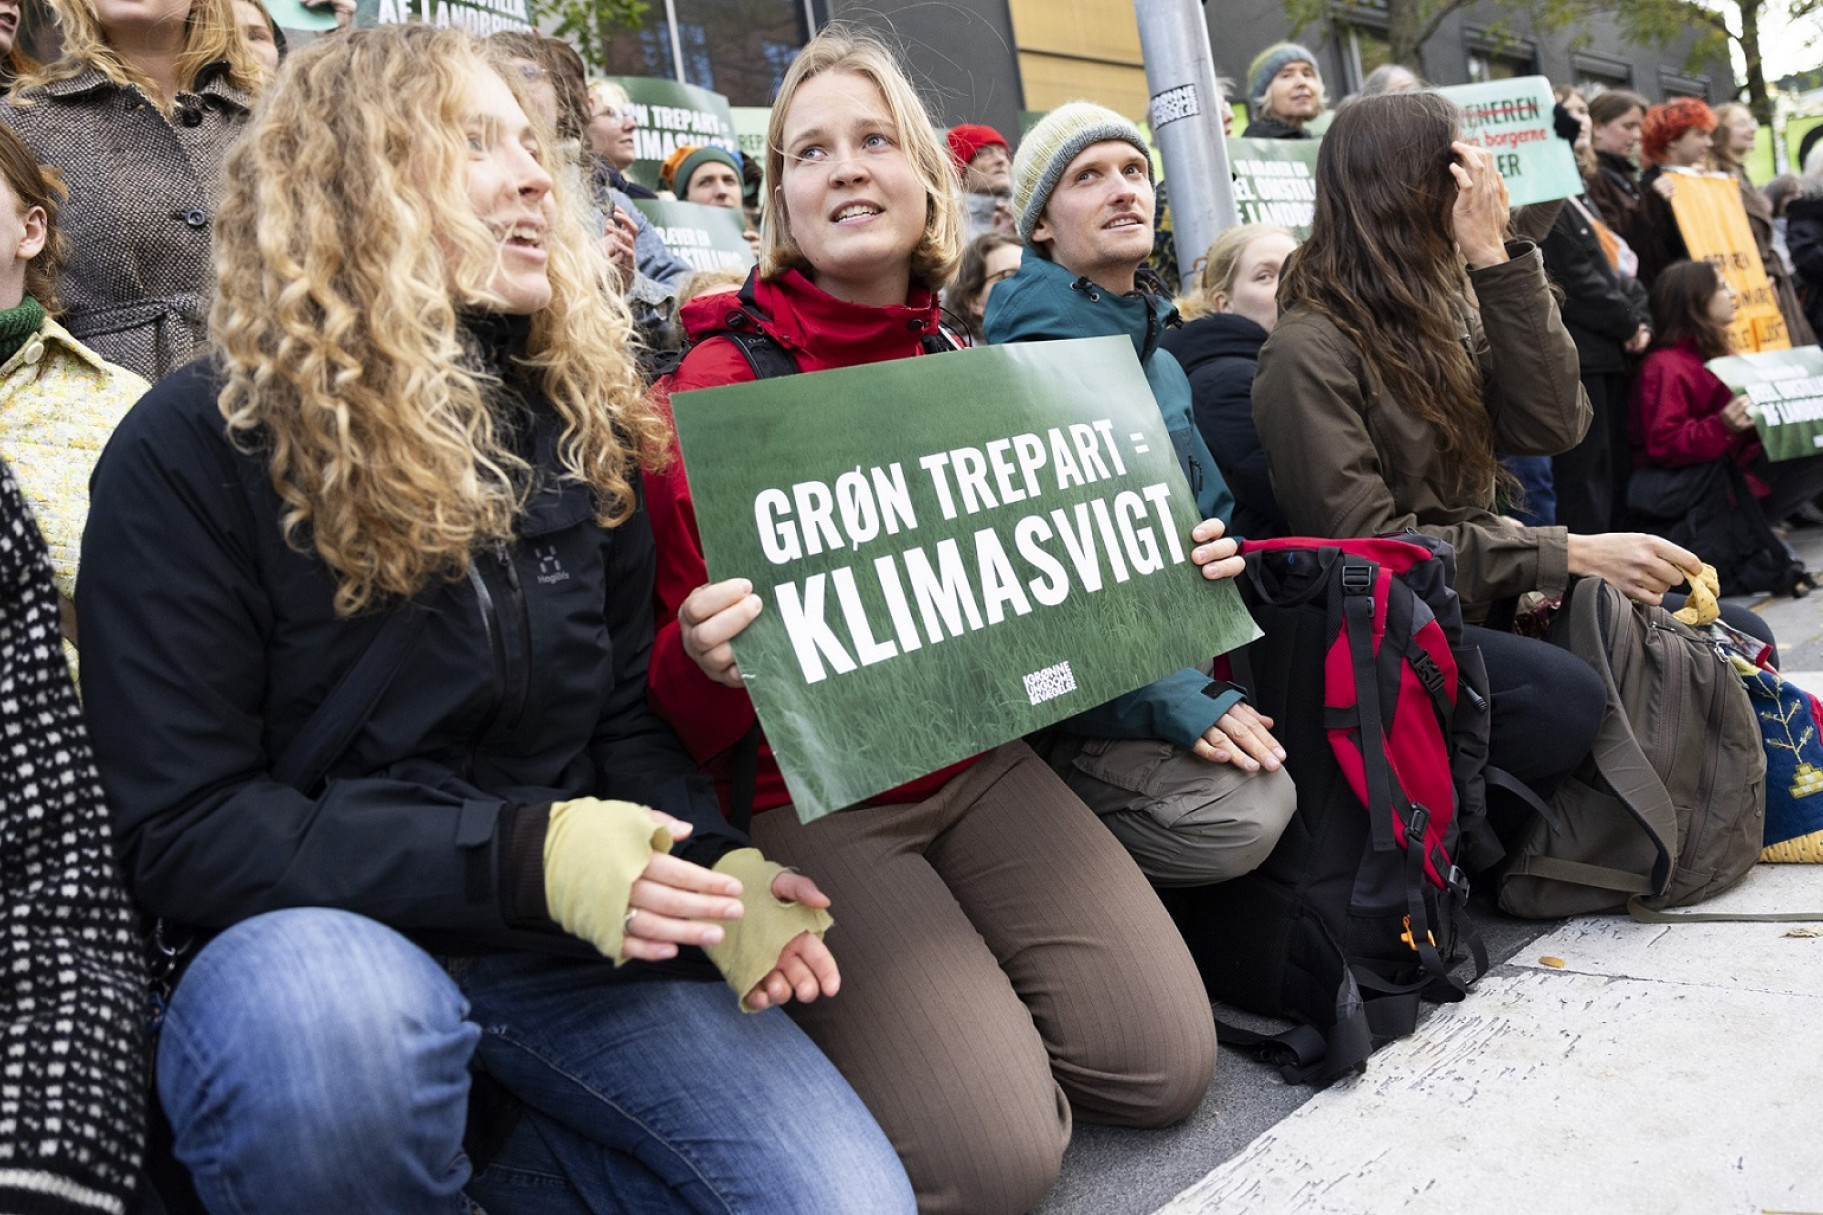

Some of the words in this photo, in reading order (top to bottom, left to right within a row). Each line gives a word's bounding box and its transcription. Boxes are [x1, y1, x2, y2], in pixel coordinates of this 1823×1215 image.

[650, 105, 719, 135] TREPART
[1497, 153, 1522, 179] ER
[754, 463, 918, 565] GRØN
[920, 418, 1127, 521] TREPART
[1129, 432, 1150, 454] =
[774, 482, 1186, 685] KLIMASVIGT
